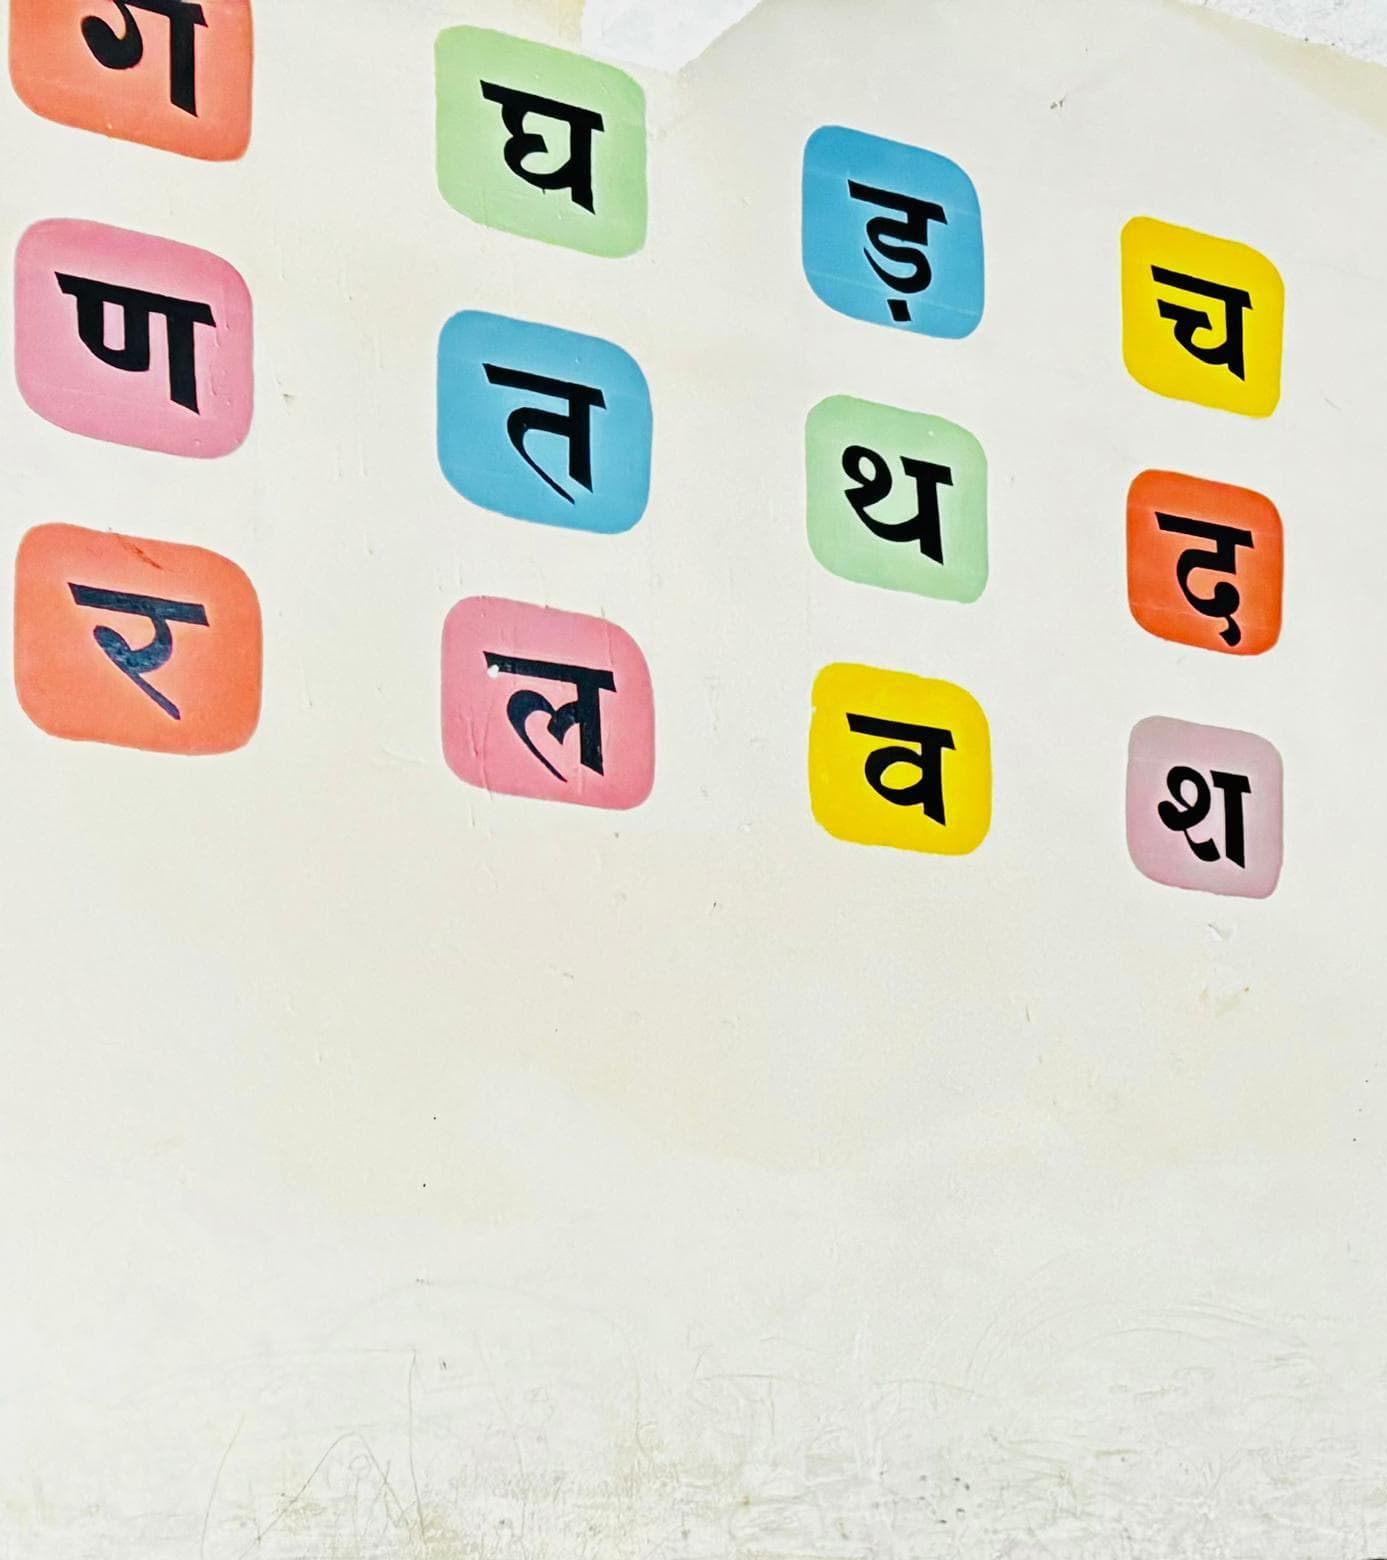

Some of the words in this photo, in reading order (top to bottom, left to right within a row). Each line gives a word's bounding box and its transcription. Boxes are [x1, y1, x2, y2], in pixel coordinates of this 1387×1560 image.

[81, 0, 207, 117] ग
[479, 79, 605, 214] घ
[1151, 265, 1253, 381] च
[54, 271, 216, 414] ण
[482, 363, 606, 503] त
[841, 445, 954, 565] थ
[1155, 511, 1254, 647] द
[68, 582, 209, 720] र
[483, 651, 617, 781] ल
[846, 713, 956, 826] व
[1157, 766, 1252, 869] श
